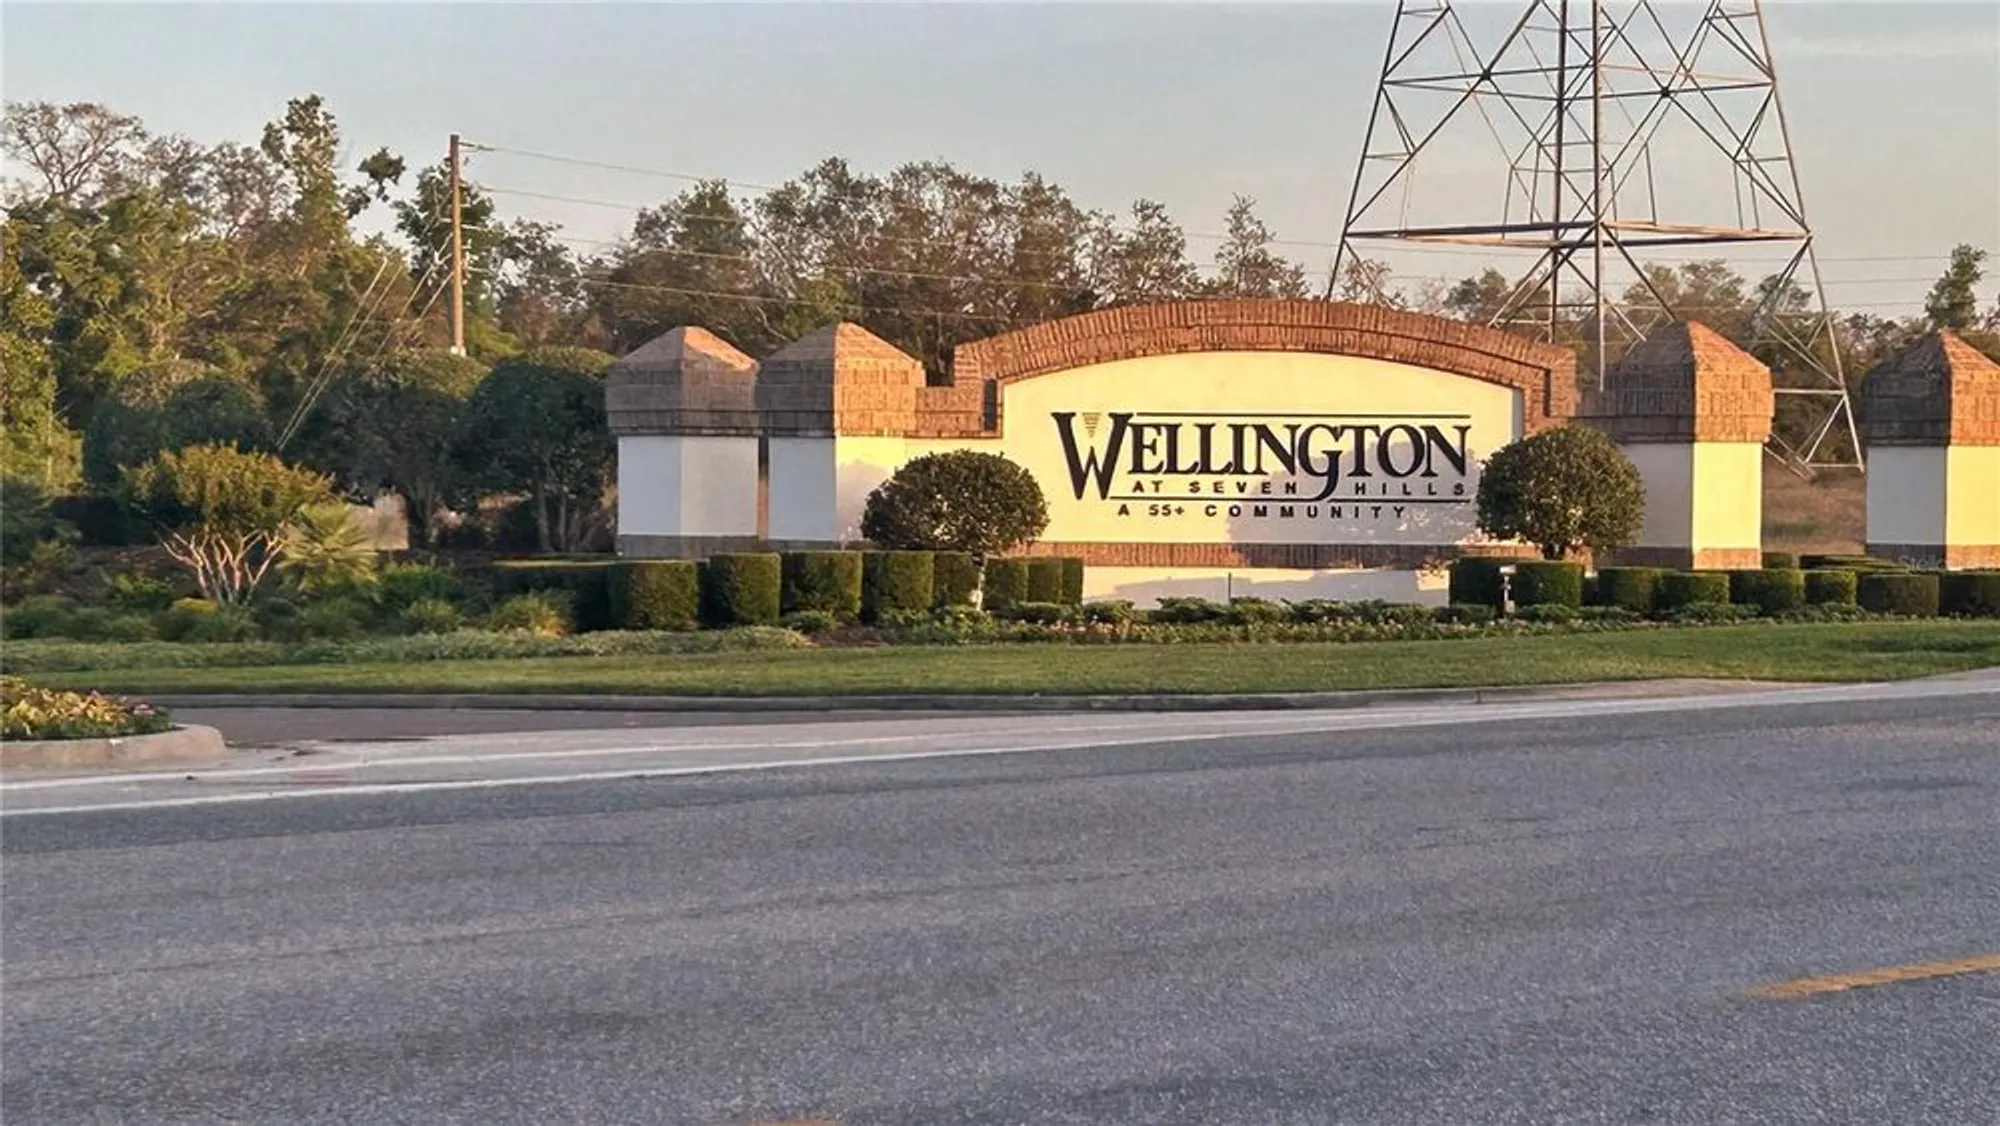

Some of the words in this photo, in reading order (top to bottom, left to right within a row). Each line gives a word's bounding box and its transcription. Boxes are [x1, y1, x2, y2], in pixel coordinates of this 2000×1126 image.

[1051, 412, 1471, 500] WELLINGTON
[1132, 480, 1163, 493] AT
[1189, 481, 1297, 494] SEVEN
[1355, 482, 1465, 496] HILLS
[1118, 504, 1130, 516] A
[1150, 504, 1185, 516] 55+
[1205, 505, 1405, 518] COMMUNITY
